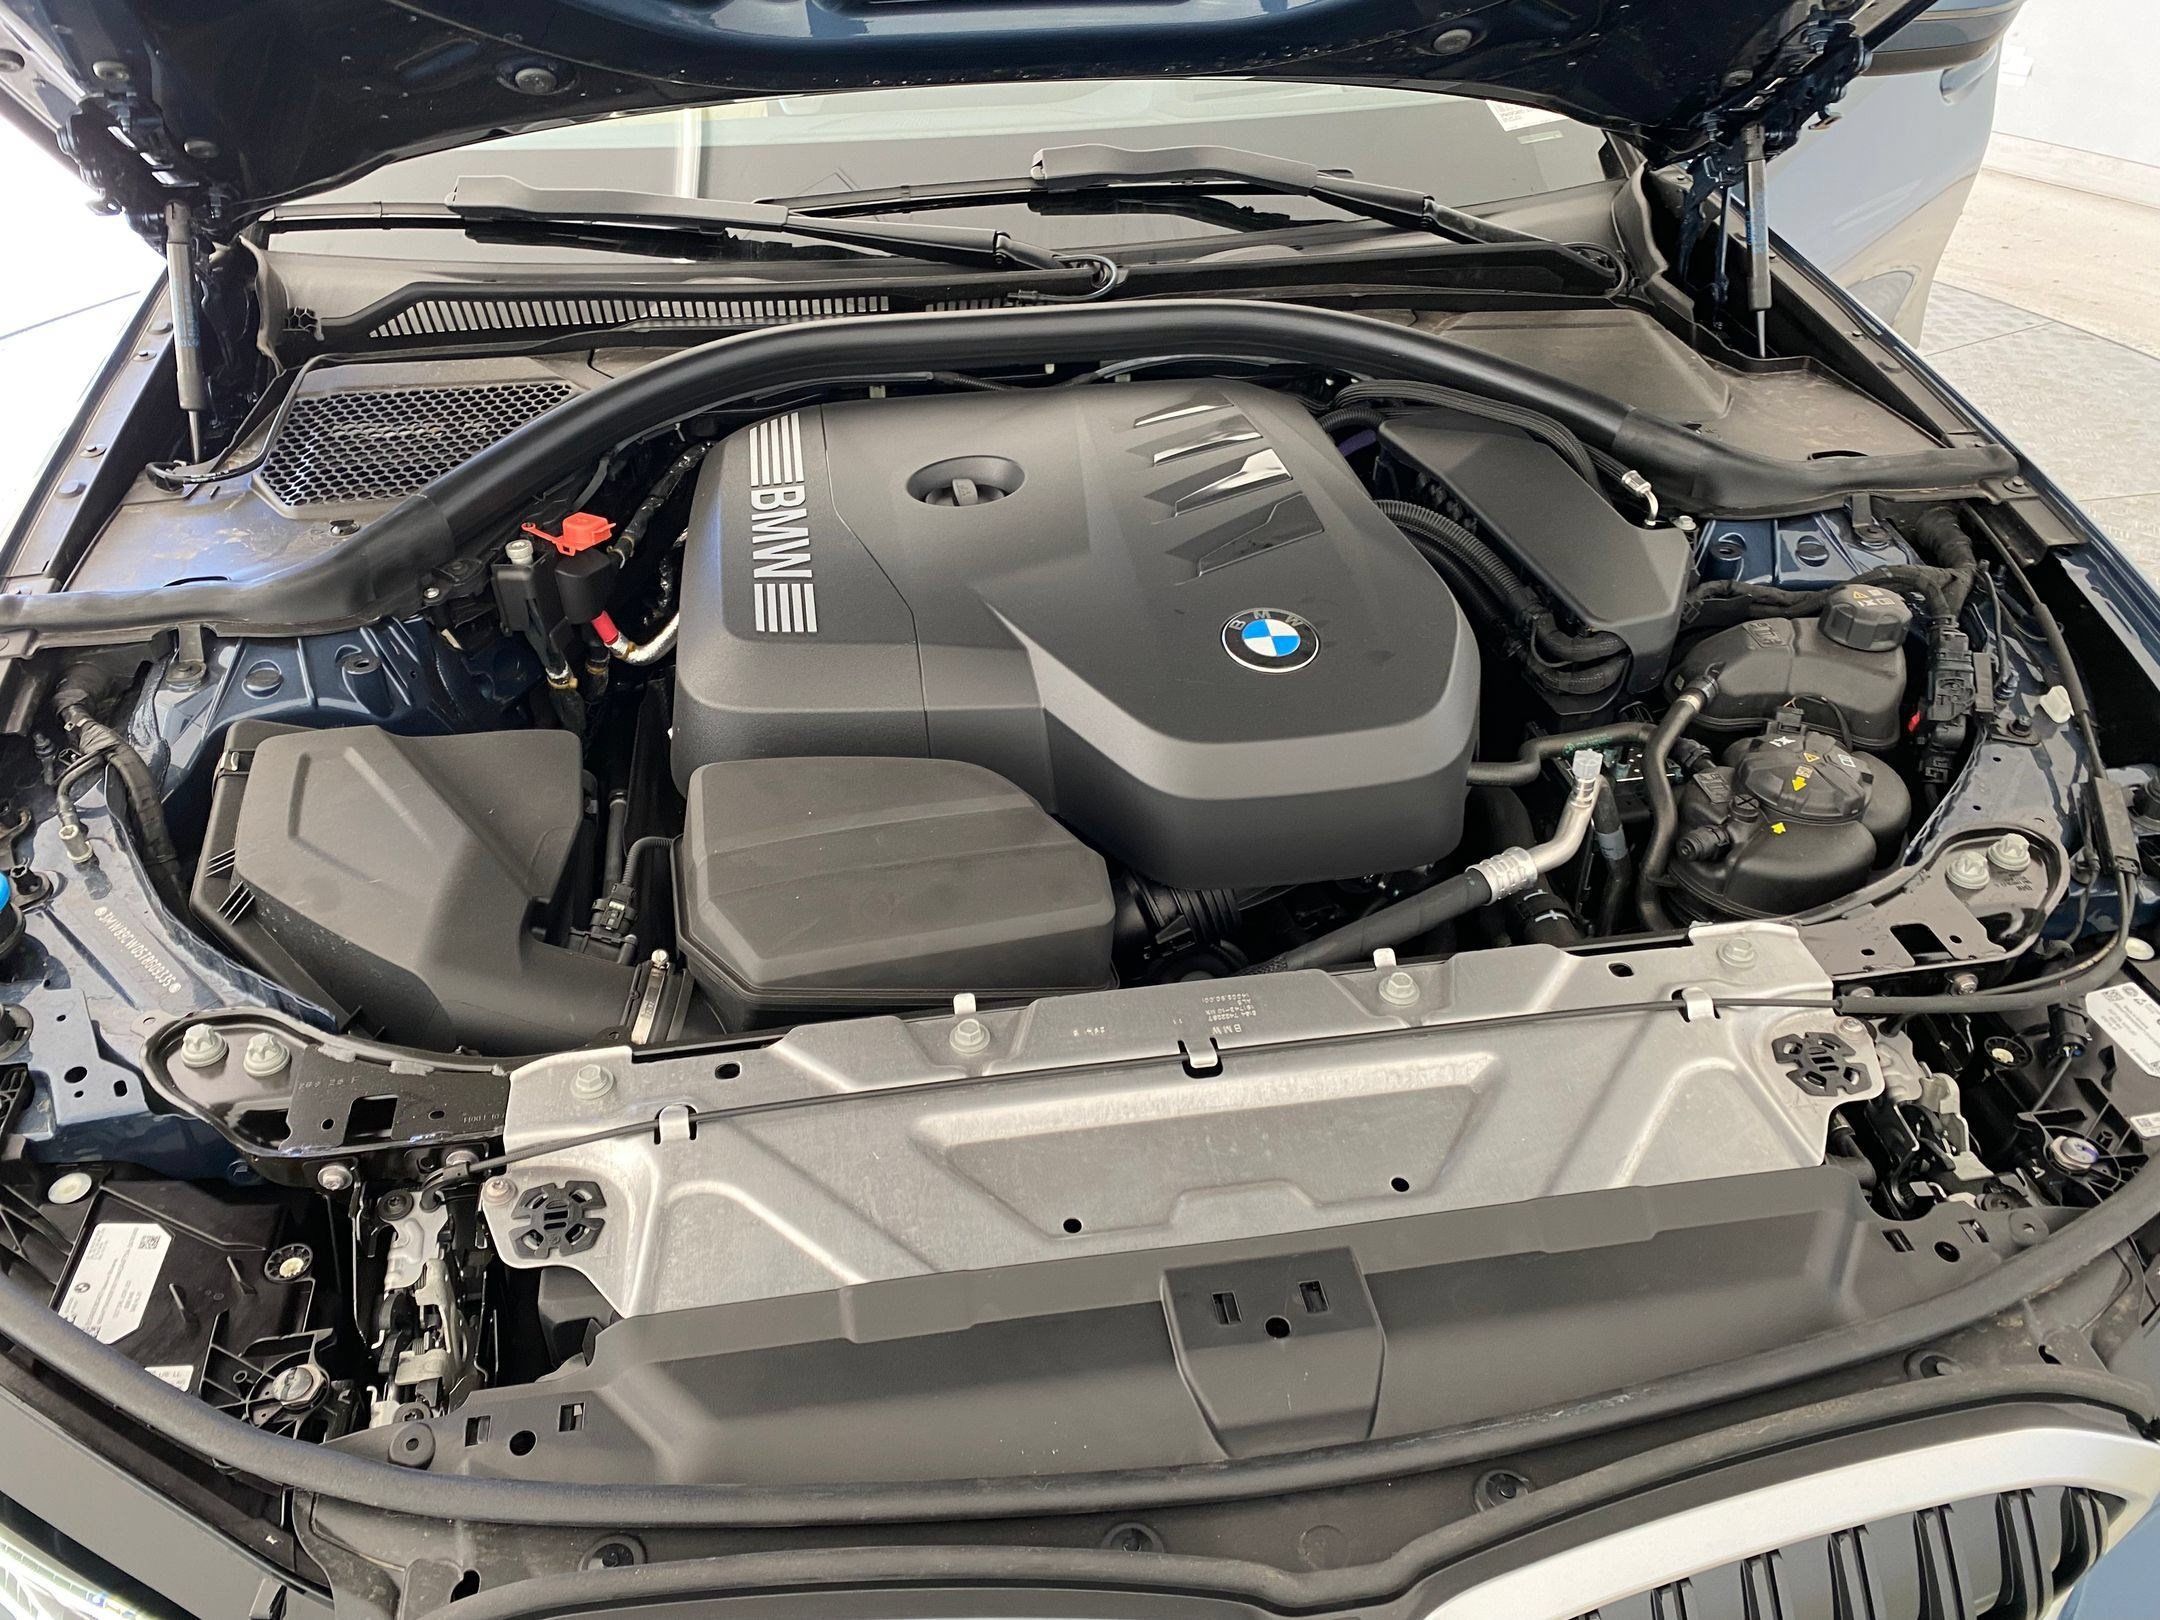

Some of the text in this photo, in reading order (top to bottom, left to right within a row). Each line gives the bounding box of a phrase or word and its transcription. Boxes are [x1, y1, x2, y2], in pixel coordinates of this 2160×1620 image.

[751, 485, 813, 579] BMW
[1229, 610, 1303, 631] BMW
[1212, 1023, 1242, 1035] BMW
